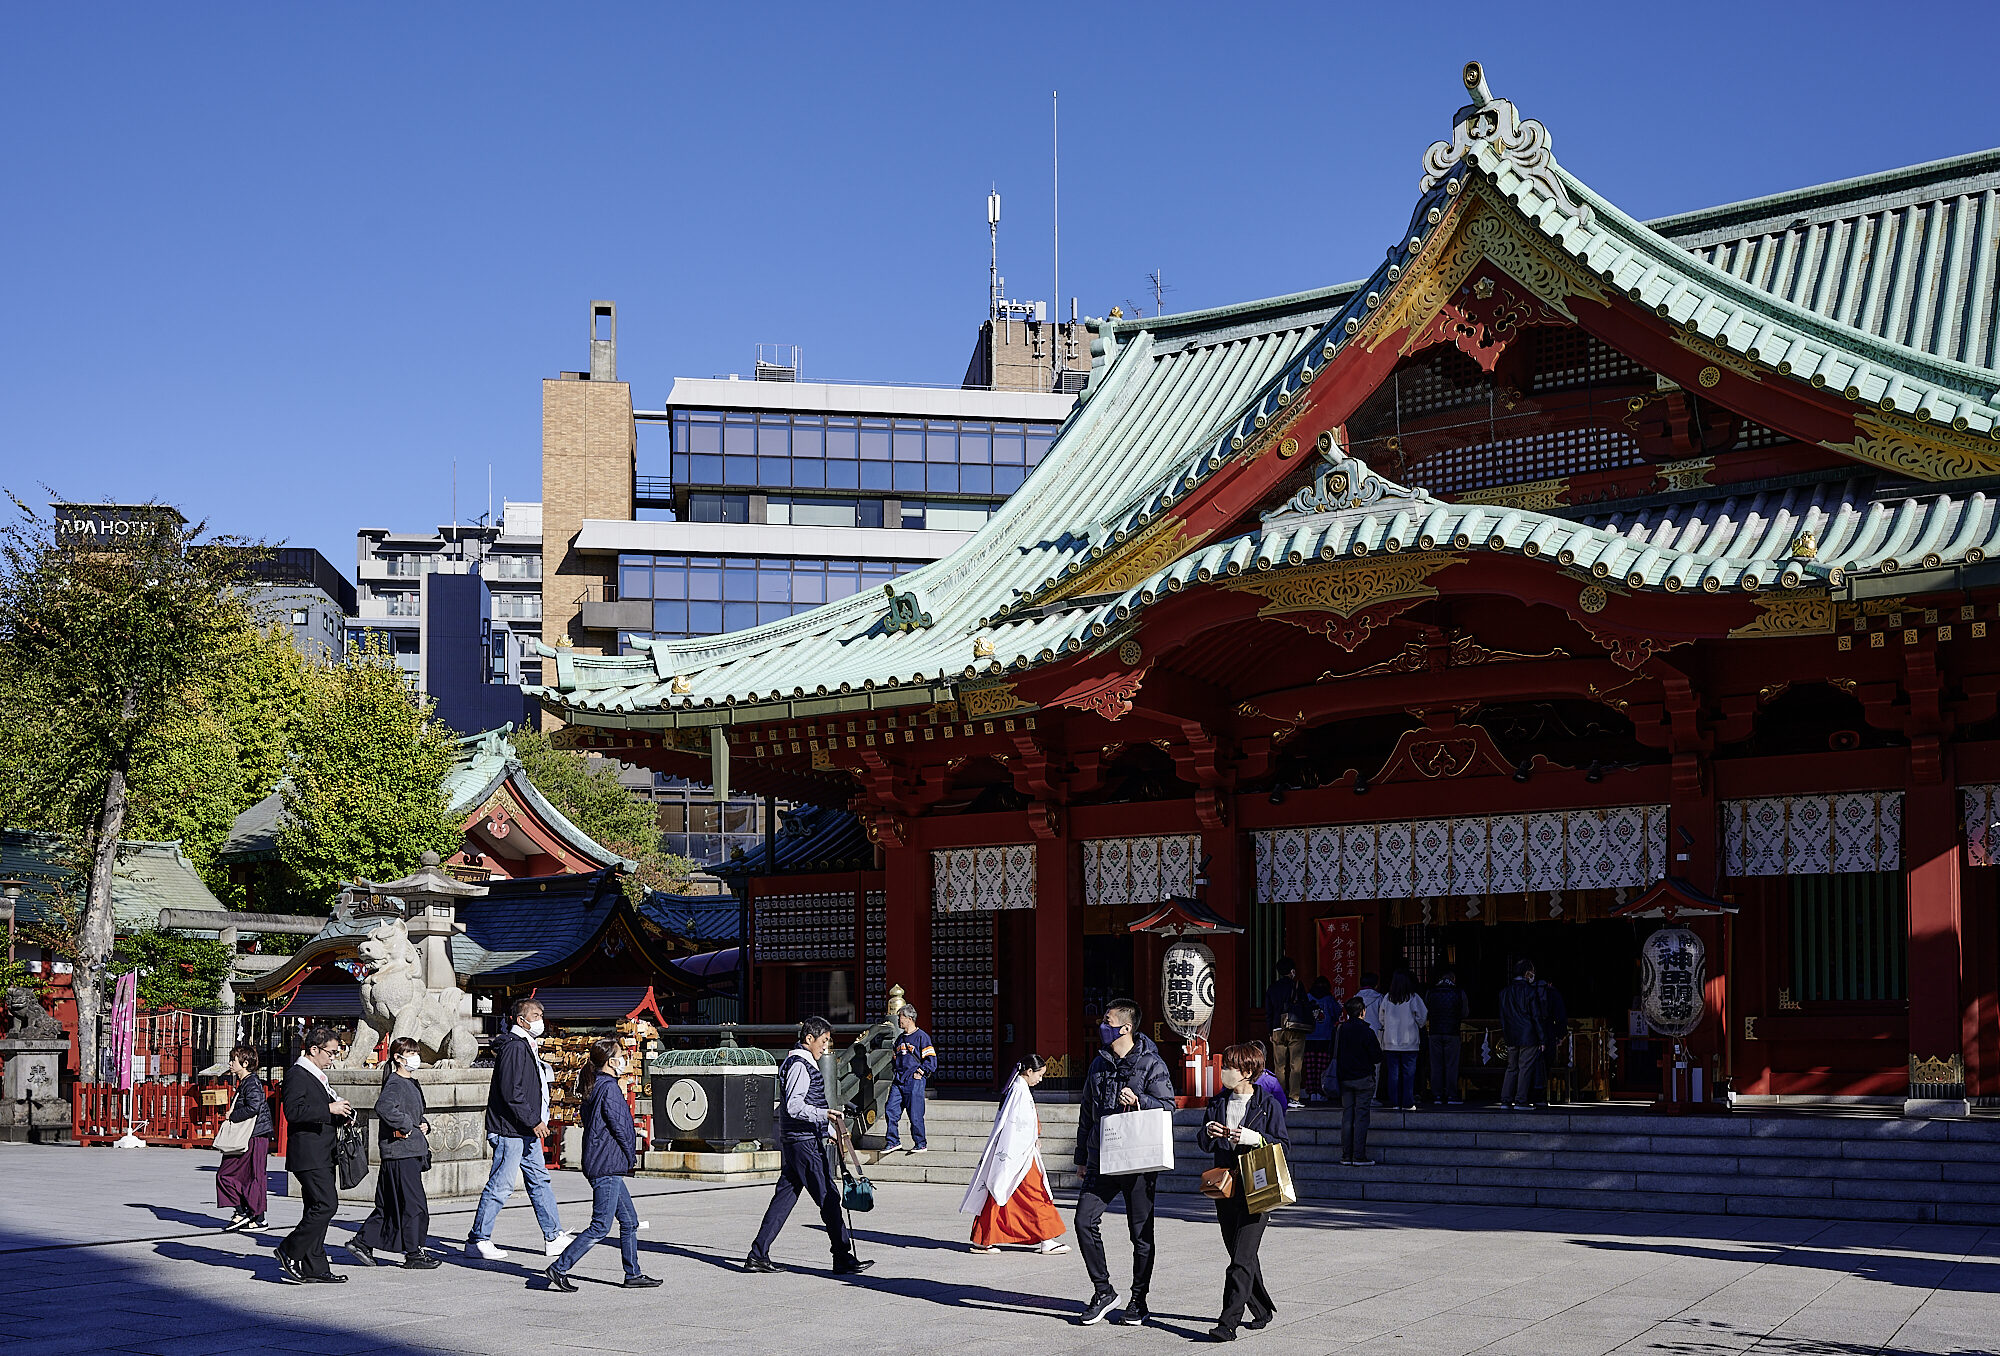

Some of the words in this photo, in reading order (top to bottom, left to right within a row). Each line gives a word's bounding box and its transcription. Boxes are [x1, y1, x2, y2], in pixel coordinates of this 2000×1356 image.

[60, 519, 97, 535] APA
[1346, 938, 1356, 977] 令和五年
[1167, 959, 1194, 1021] 神田明神
[1658, 948, 1693, 1020] 神田明神
